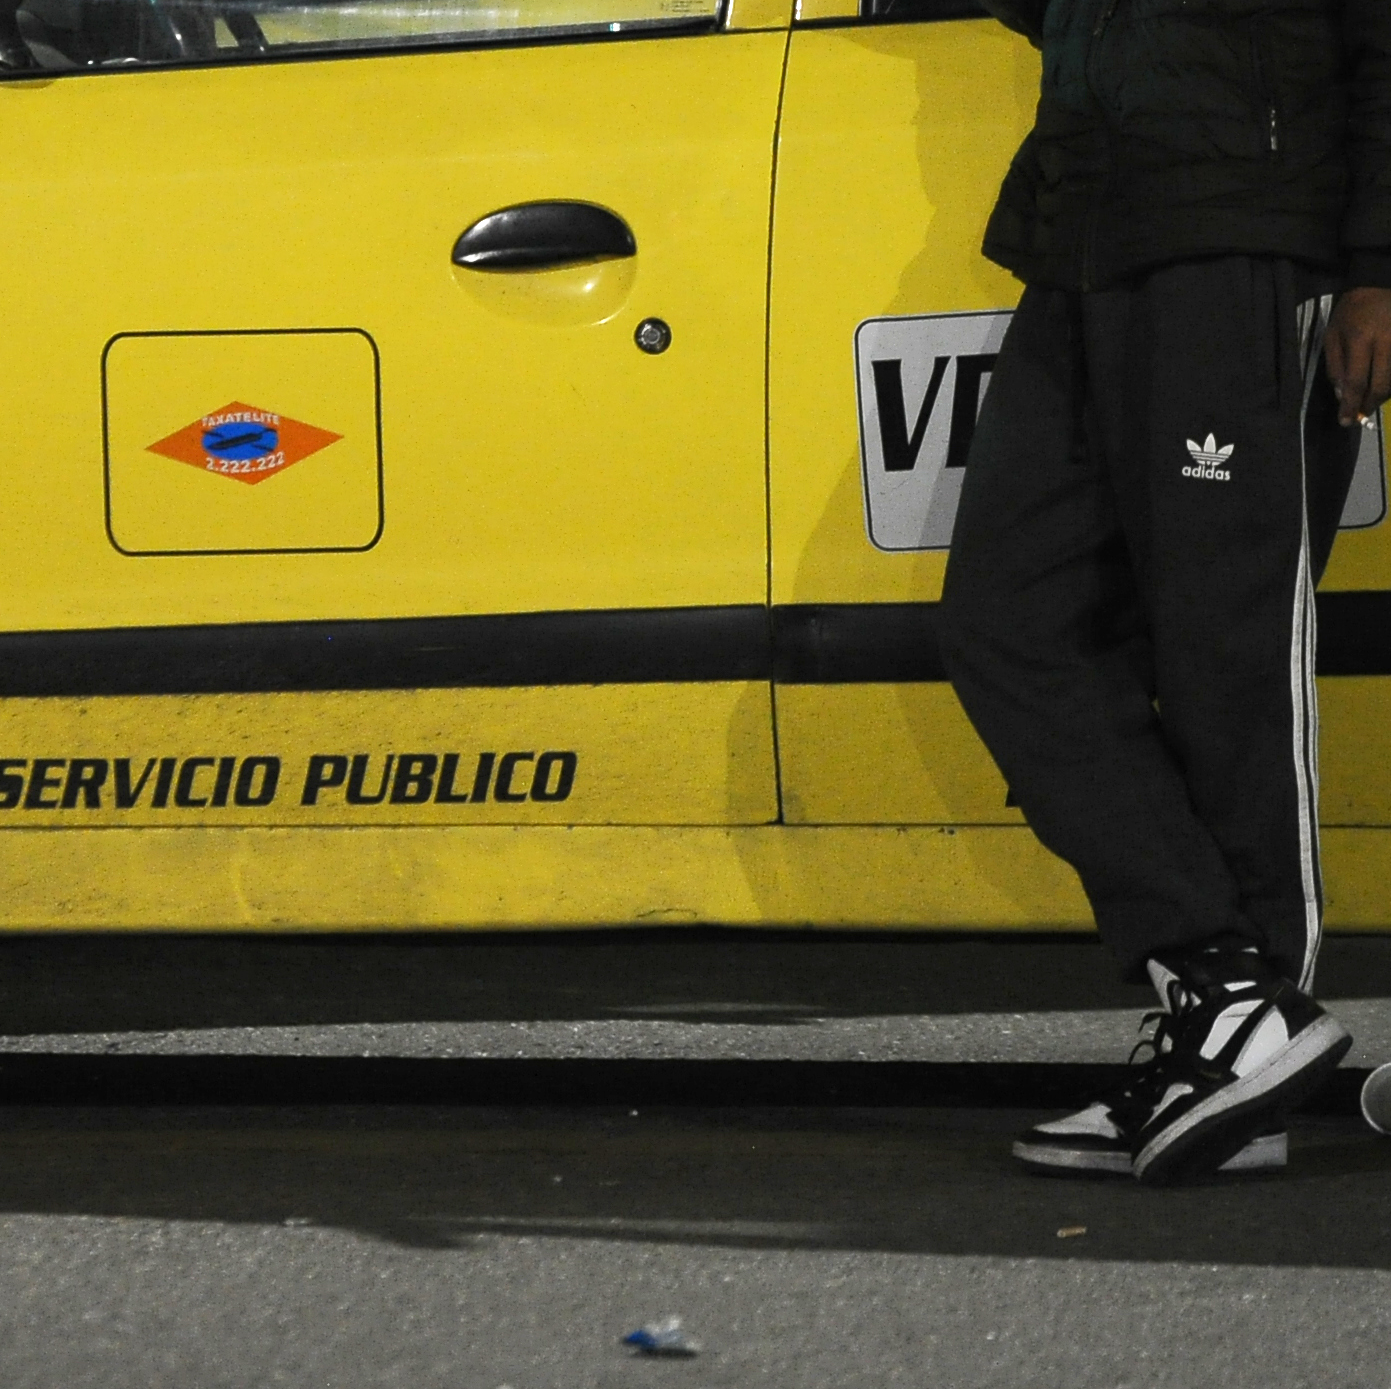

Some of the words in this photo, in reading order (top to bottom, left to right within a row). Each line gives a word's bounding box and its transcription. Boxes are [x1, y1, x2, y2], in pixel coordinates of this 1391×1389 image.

[206, 451, 285, 474] 2.222.222
[1181, 464, 1231, 481] adidas
[300, 750, 578, 806] PUBLICO
